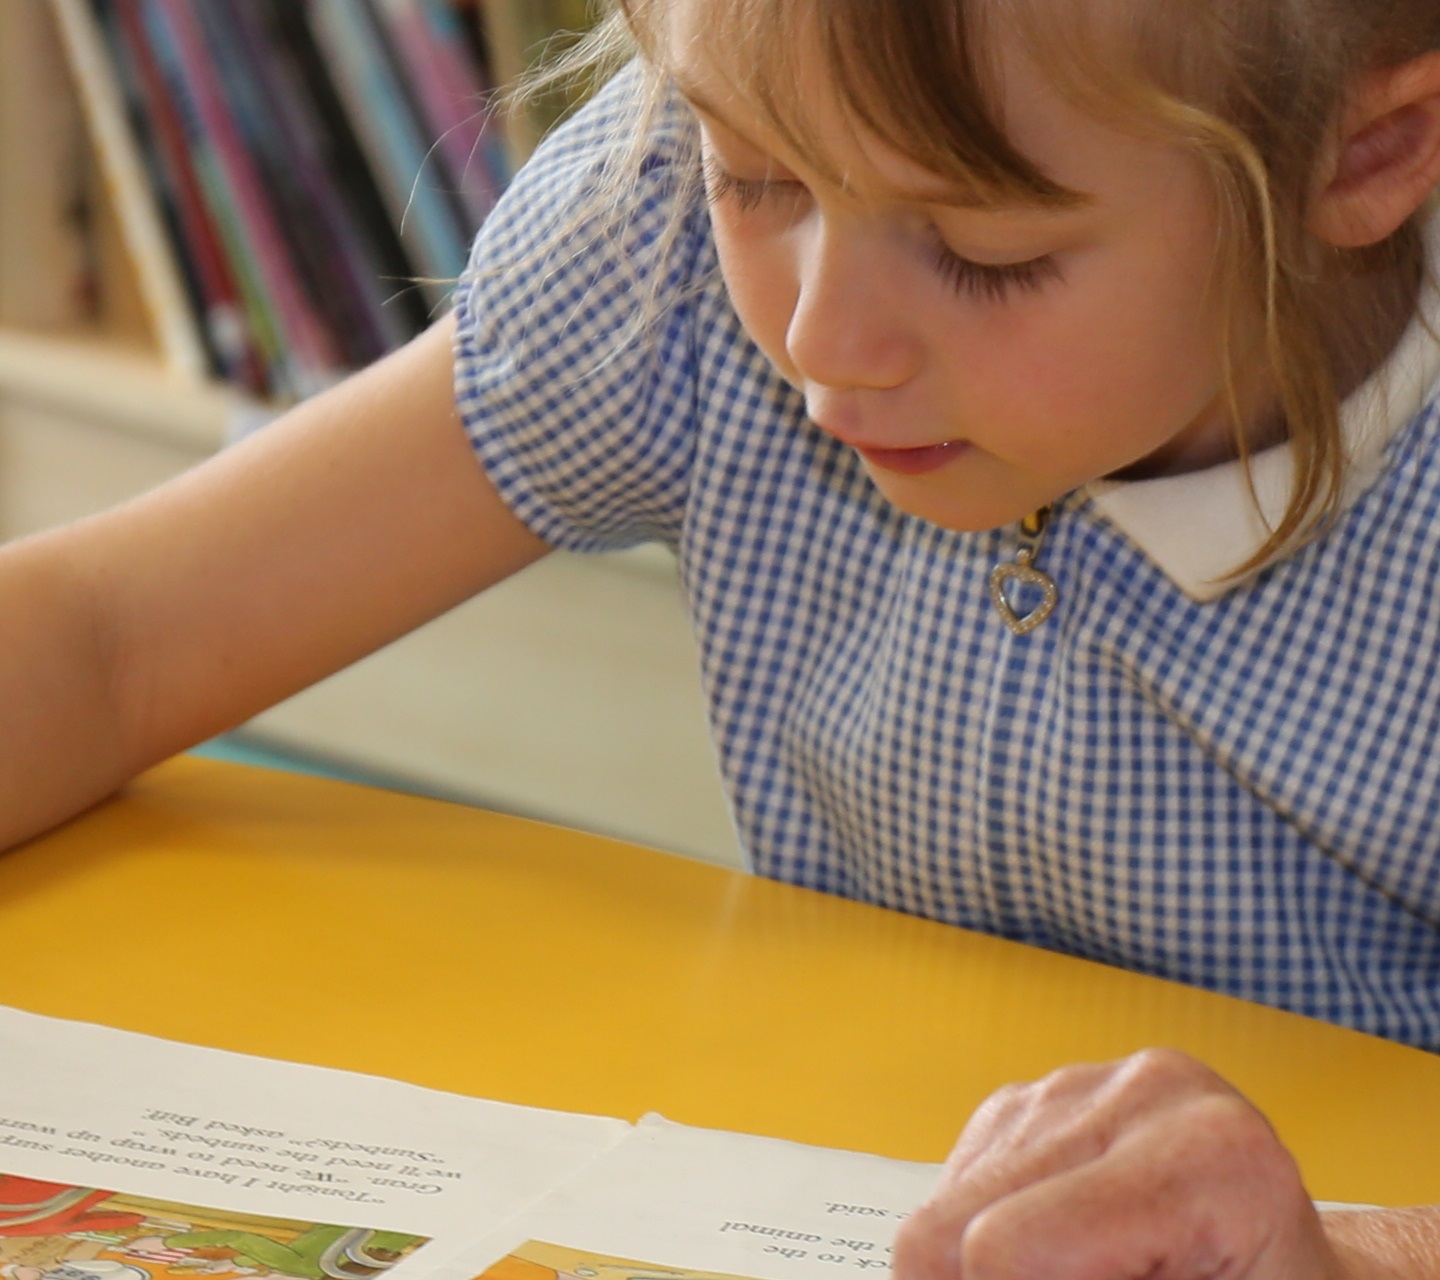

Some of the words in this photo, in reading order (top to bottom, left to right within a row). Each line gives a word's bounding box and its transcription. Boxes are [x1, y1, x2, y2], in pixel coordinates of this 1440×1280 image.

[141, 1107, 201, 1129] Biff.
[66, 1127, 102, 1144] up
[204, 1120, 285, 1139] asked
[110, 1136, 177, 1160] wrap
[187, 1149, 216, 1163] to
[275, 1149, 319, 1164] the
[58, 1146, 166, 1171] another
[222, 1155, 288, 1173] need
[324, 1155, 393, 1175] need
[172, 1164, 236, 1186] have
[243, 1175, 262, 1189] I
[366, 1174, 444, 1196] Gran.
[824, 1200, 890, 1218] said.
[719, 1220, 822, 1243] animal
[762, 1244, 808, 1259] the
[830, 1237, 876, 1252] the
[816, 1252, 847, 1265] to
